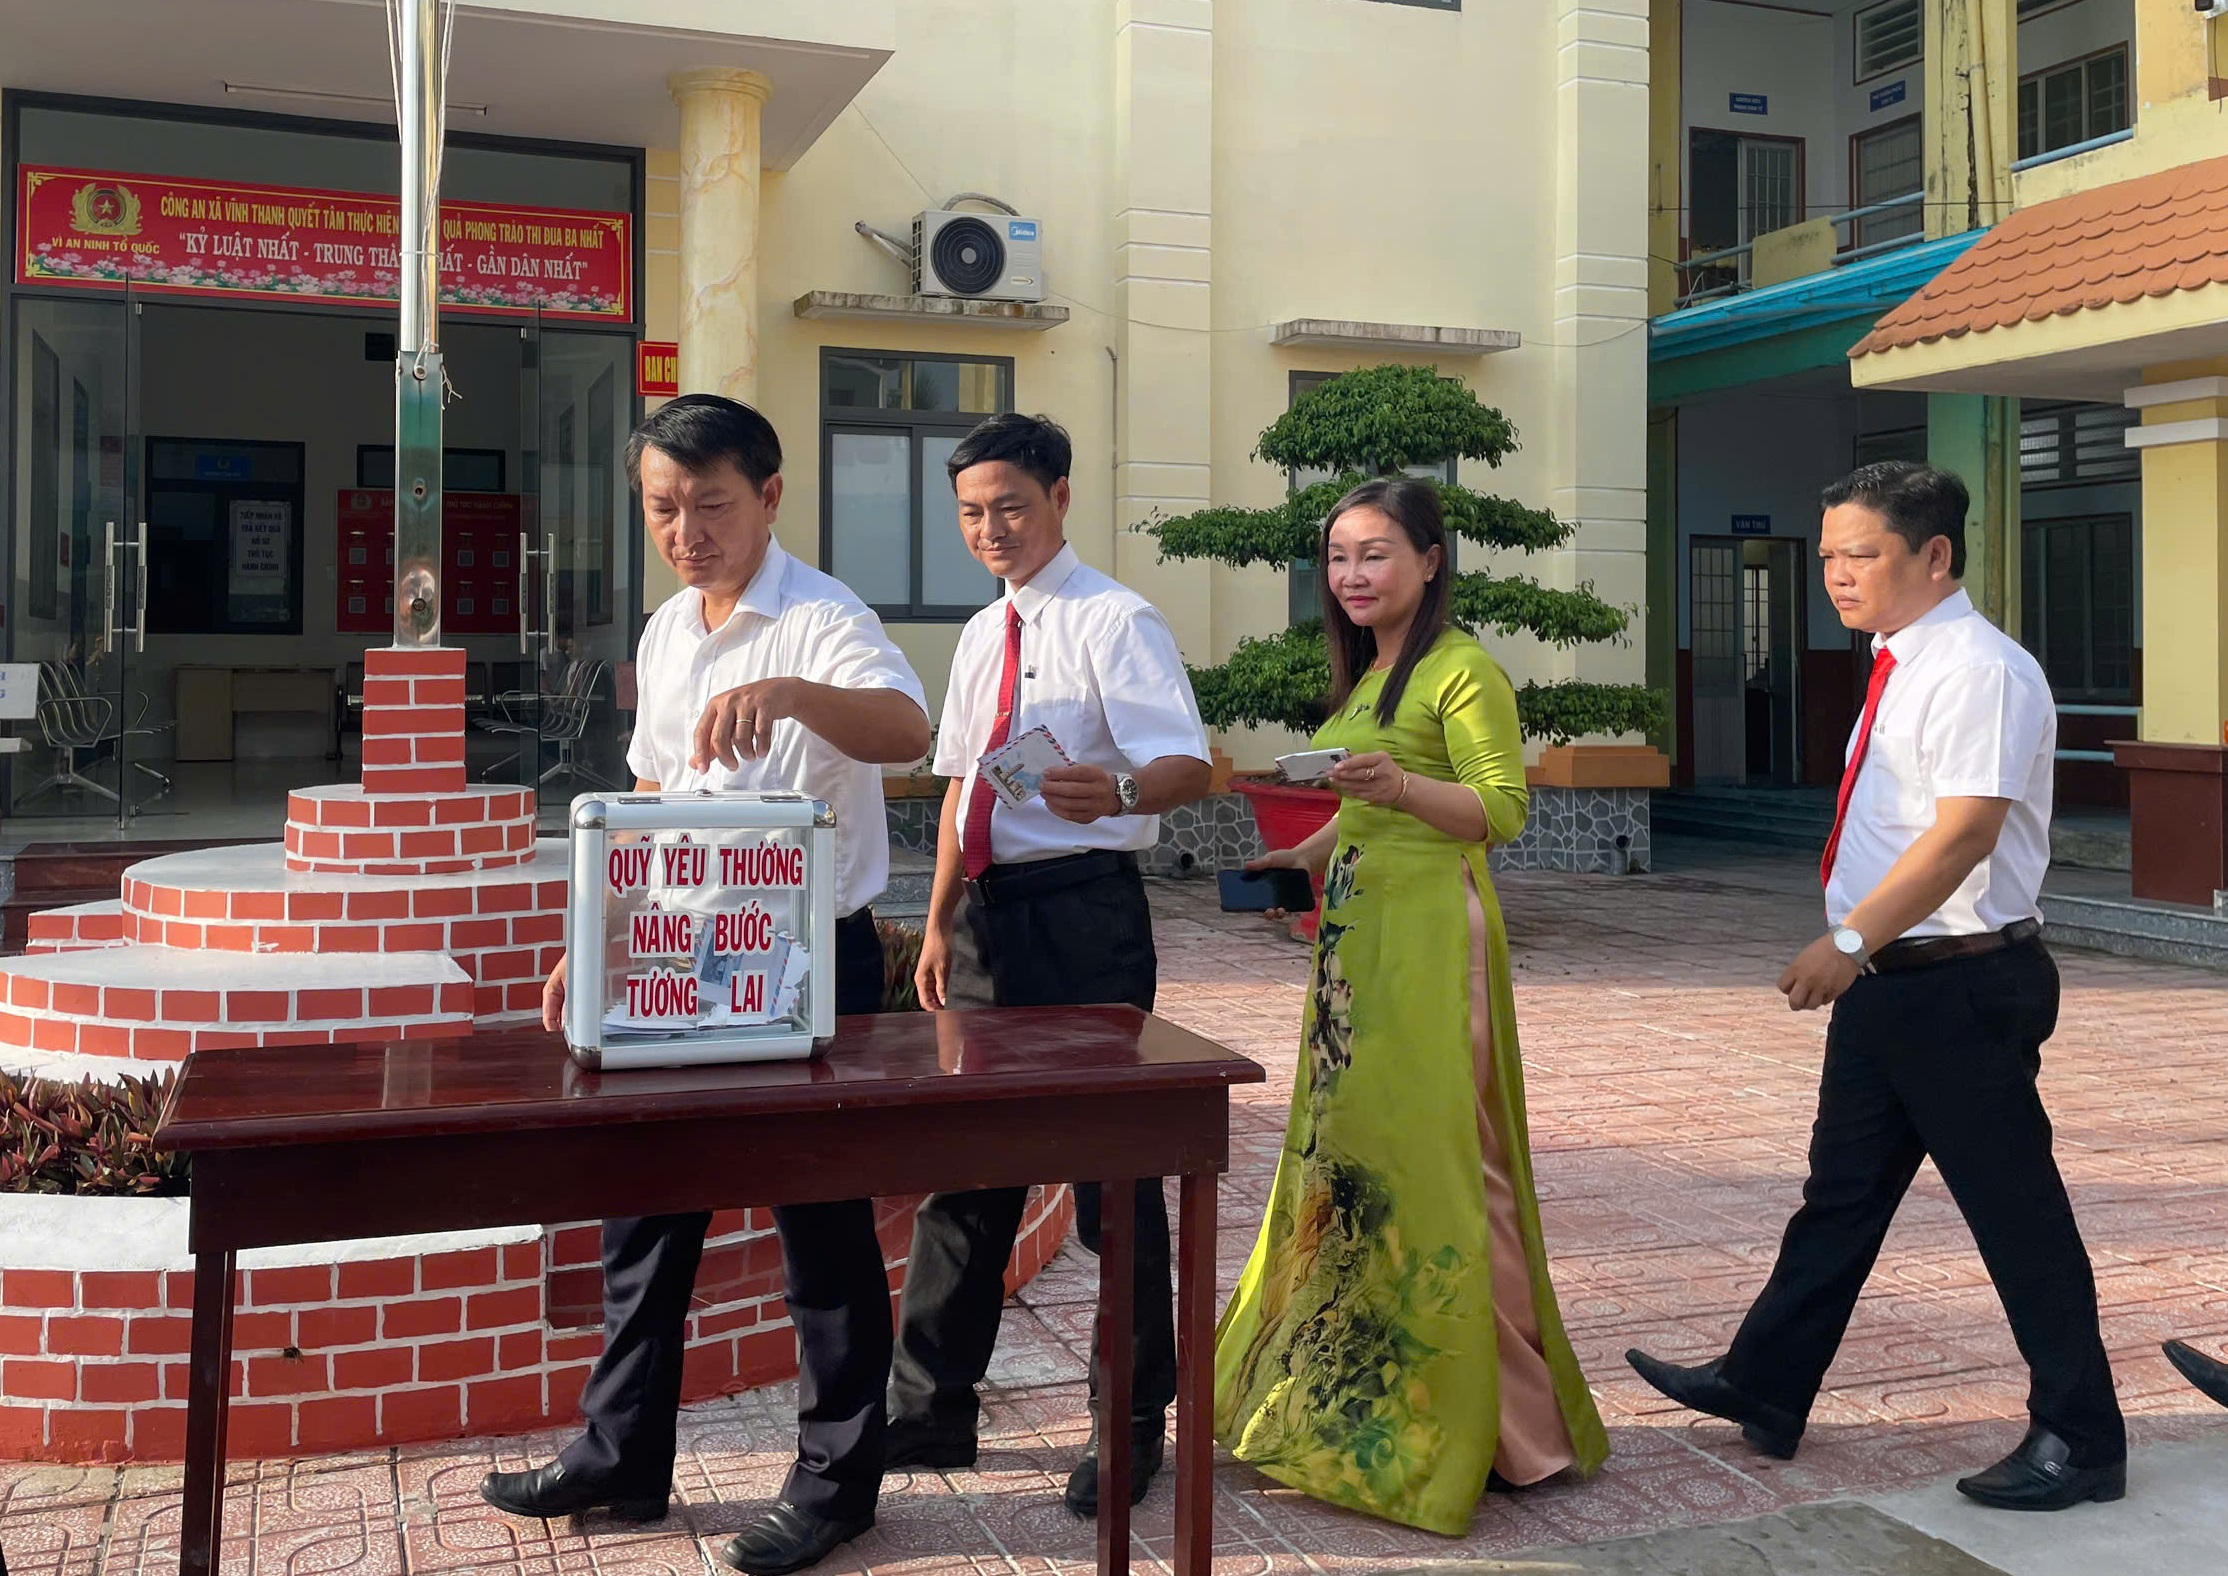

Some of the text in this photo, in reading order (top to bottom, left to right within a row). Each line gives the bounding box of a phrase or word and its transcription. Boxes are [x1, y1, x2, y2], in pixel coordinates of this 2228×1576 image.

[161, 191, 188, 218] CÔNG
[191, 199, 205, 219] AN
[208, 196, 222, 220] XÃ
[225, 197, 248, 223] VĨNH
[251, 204, 285, 226] THANH
[288, 202, 320, 229] QUYẾT
[323, 204, 344, 230] TÂM
[348, 210, 373, 236] THỰC
[376, 210, 399, 237] HIỆN
[443, 212, 462, 241] QUẢ
[465, 221, 496, 242] PHONG
[526, 225, 541, 245] THI
[544, 226, 562, 246] ĐUA
[565, 228, 578, 248] BA
[579, 223, 604, 249] NHẤT
[52, 234, 160, 254] VÌ AN NINH TỔ QUỐC
[213, 231, 253, 261] LUẬT
[257, 231, 300, 261] NHẤT
[314, 242, 363, 266] TRUNG
[477, 244, 507, 275] GẦN
[511, 253, 540, 278] DÂN
[645, 355, 663, 382] BAN
[609, 835, 803, 894] QUỸ YÊU THƯƠNG
[632, 900, 772, 953] NÂNG BƯỚC
[627, 971, 764, 1018] TƯƠNG LAI
